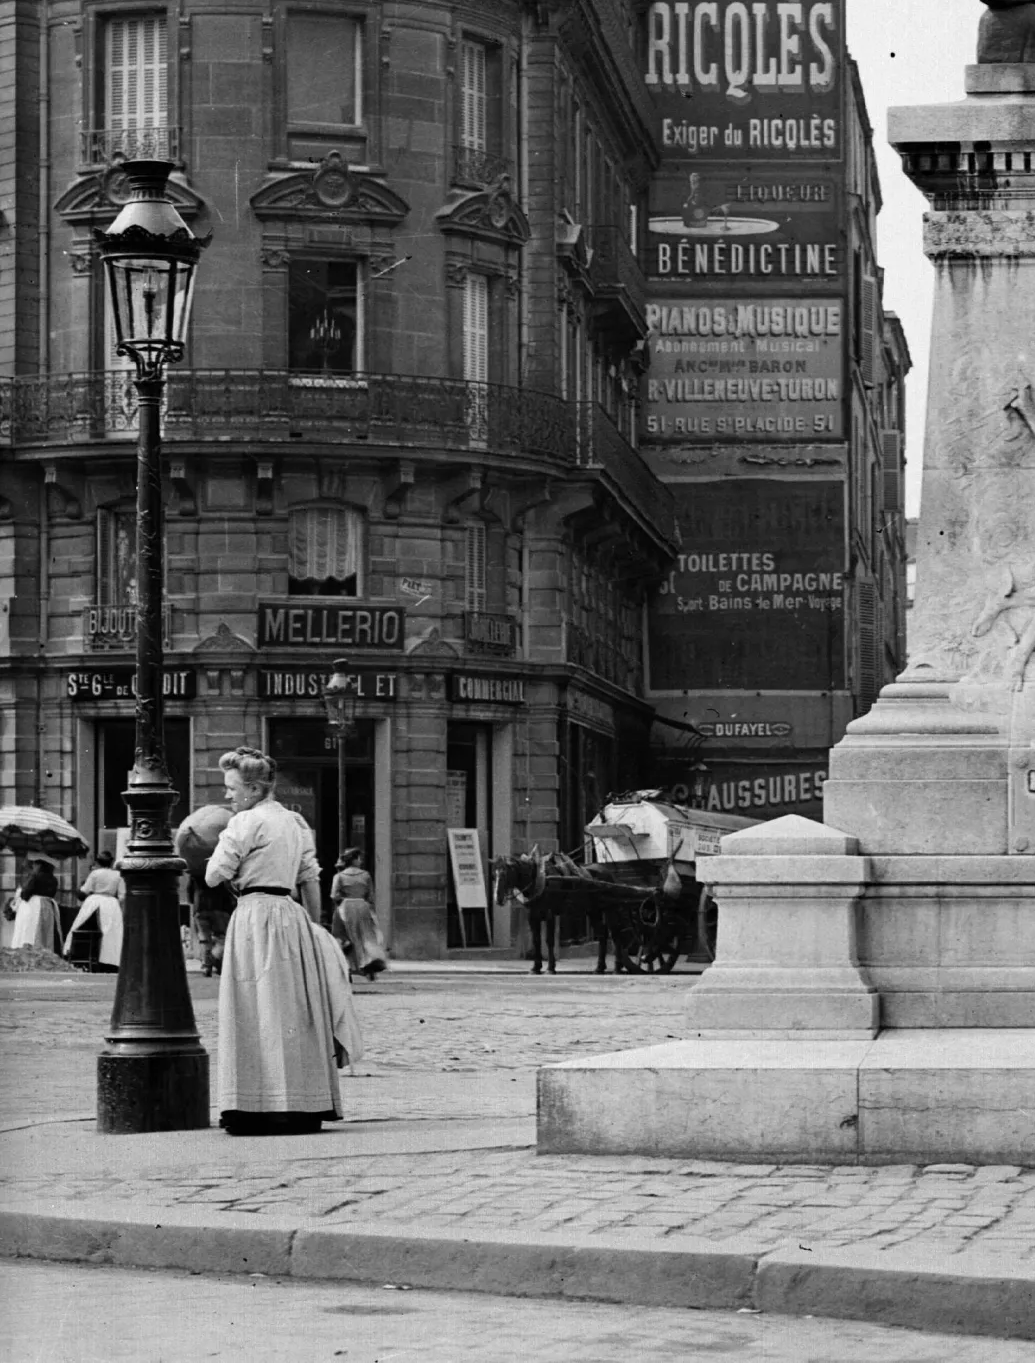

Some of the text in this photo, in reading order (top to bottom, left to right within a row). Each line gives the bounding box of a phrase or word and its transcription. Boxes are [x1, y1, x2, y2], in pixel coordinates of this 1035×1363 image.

[662, 114, 835, 153] Exiger du RICQLÈS
[736, 184, 827, 203] LIQUEUR
[658, 238, 838, 275] BÉNÉDICTINE
[645, 303, 726, 337] PIANOS
[736, 304, 841, 339] MUSIQUE
[756, 339, 820, 353] Musical
[749, 359, 807, 374] BARON
[677, 553, 776, 572] TOILETTES
[718, 572, 843, 593] DE CAMPAGNE
[708, 594, 753, 611] Bains
[772, 594, 804, 611] Mer
[264, 608, 400, 645] MELLERIO
[131, 672, 188, 697] CDIT
[266, 672, 365, 697] INDUSTL
[376, 673, 397, 698] ET
[459, 677, 525, 703] COMMERCIAL
[715, 722, 772, 737] DUFAYEL
